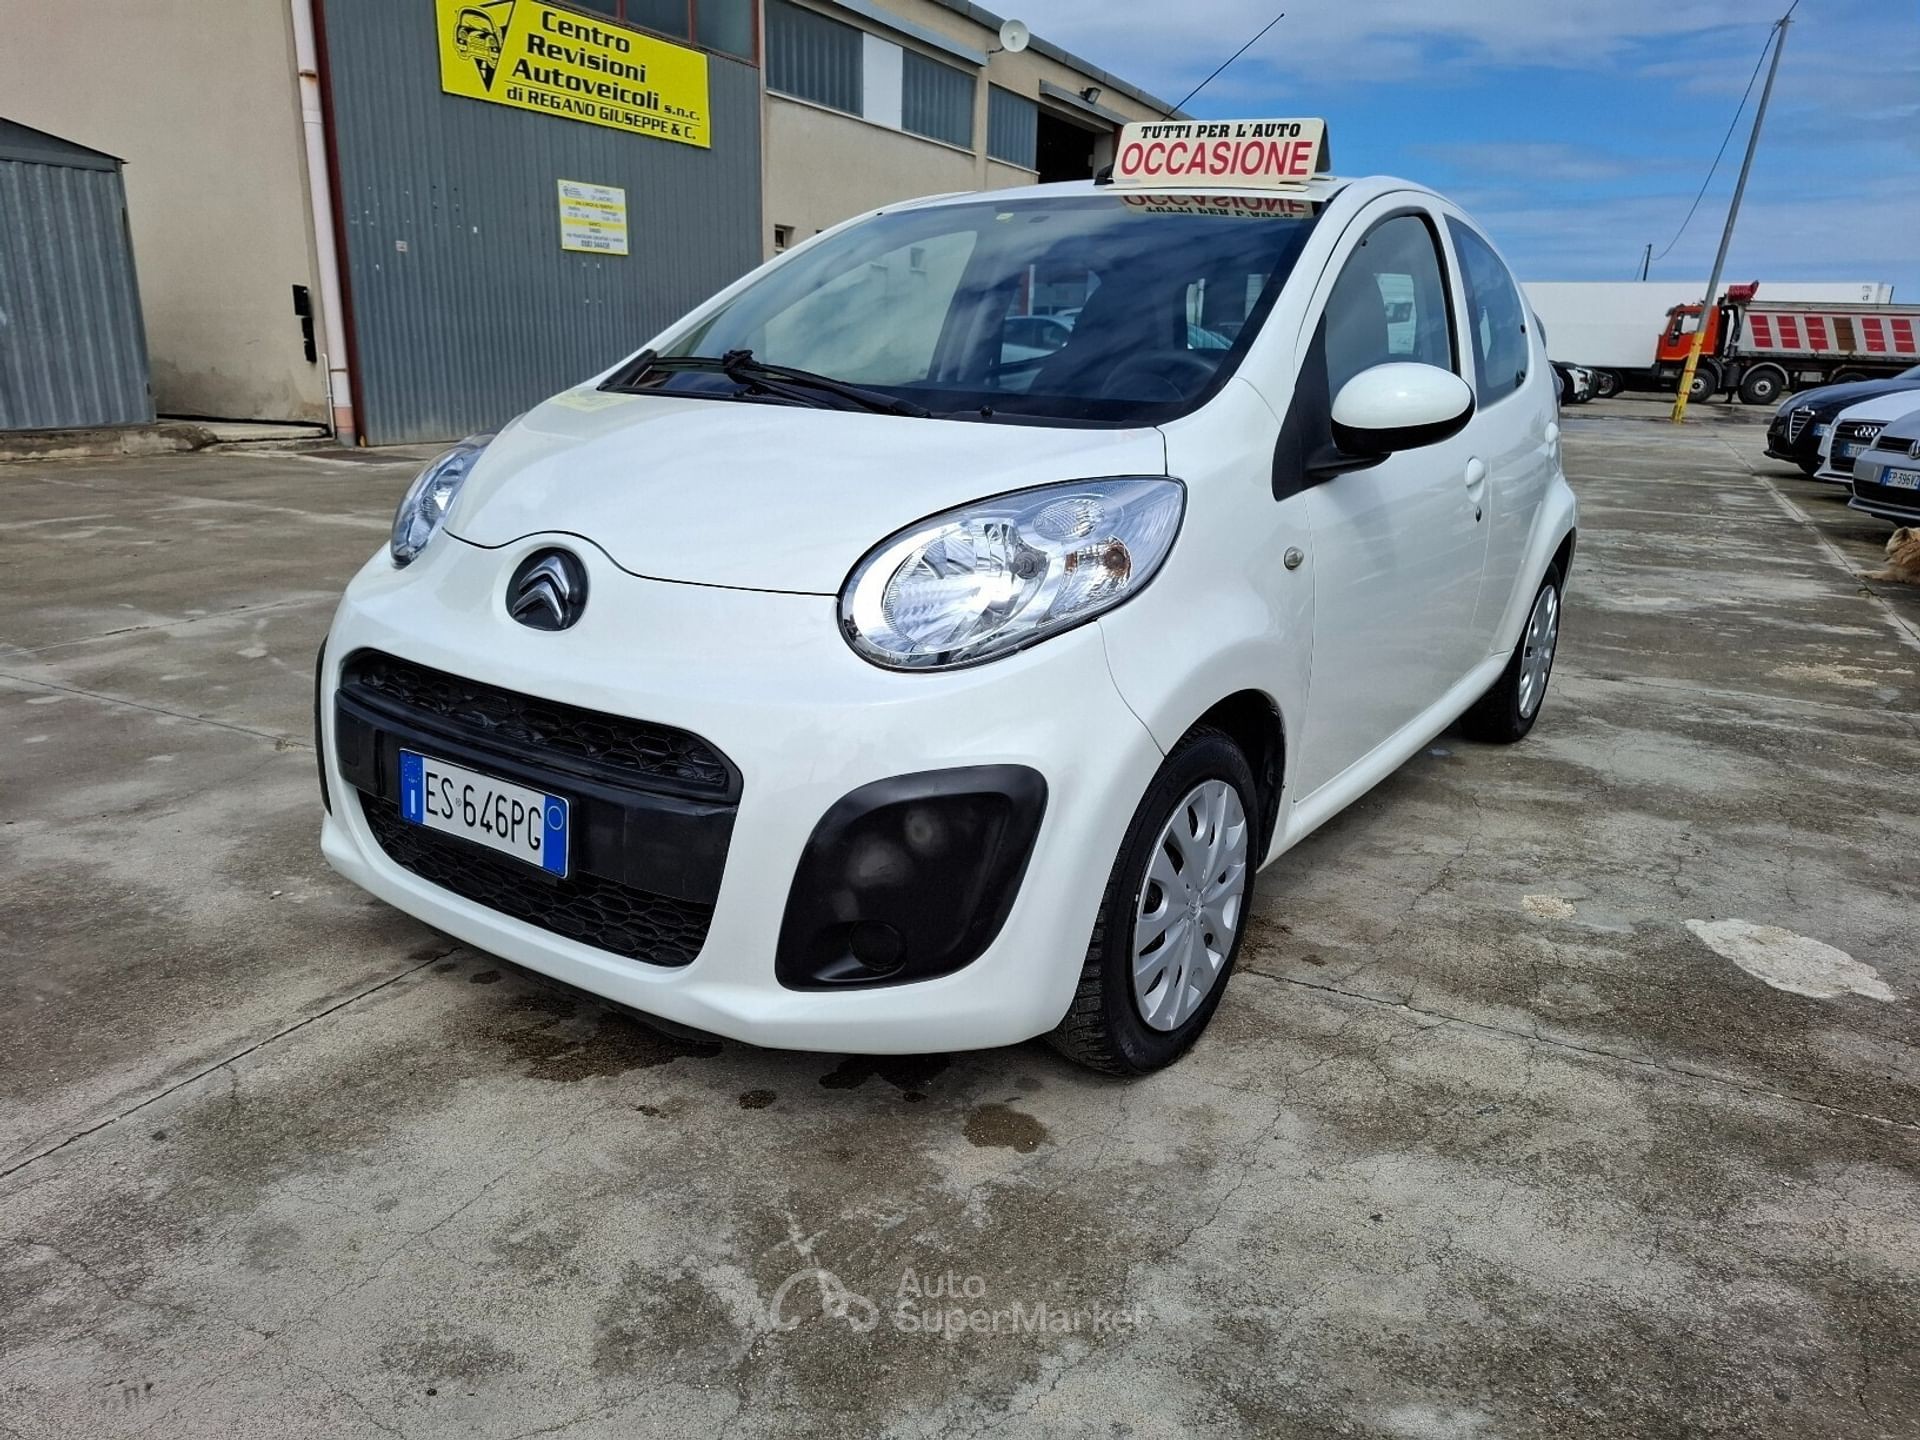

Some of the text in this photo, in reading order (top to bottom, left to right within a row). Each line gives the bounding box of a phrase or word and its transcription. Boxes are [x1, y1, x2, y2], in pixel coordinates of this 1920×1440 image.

[541, 10, 630, 54] Centro
[527, 33, 646, 83] Revisioni
[506, 86, 697, 140] di REGANO GIUSEPPE & C.
[512, 58, 700, 121] Autoveicoli s.n.c.
[1141, 123, 1302, 139] TUTTI PER L'AUTO
[1121, 141, 1313, 176] OCCASIONE
